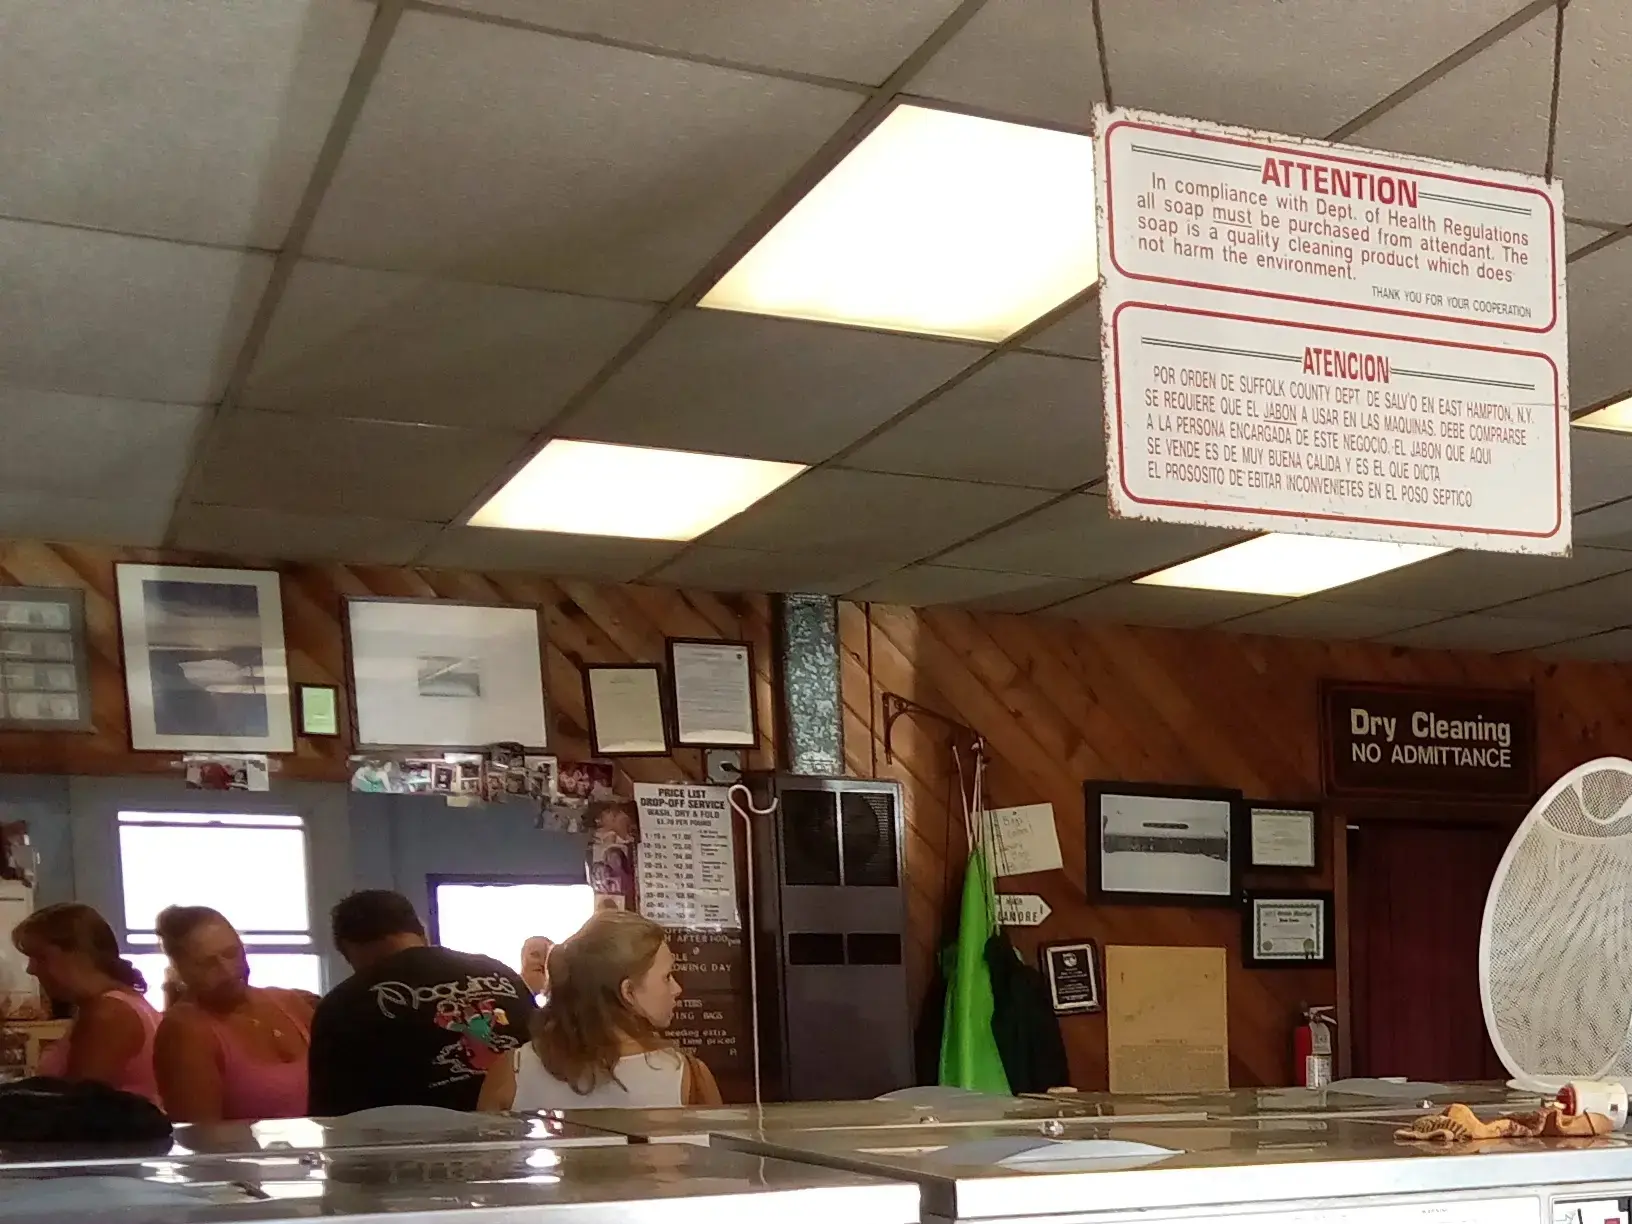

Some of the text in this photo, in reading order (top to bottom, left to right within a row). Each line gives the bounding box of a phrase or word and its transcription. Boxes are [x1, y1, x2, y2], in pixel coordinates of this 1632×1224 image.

[1260, 155, 1419, 209] ATTENTION
[1136, 190, 1528, 266] all soap must be purchased from attendant. The
[1151, 171, 1529, 250] In compliance with Dept. of Health Regulations
[1137, 214, 1513, 283] soap is a quality cleaning product which does
[1137, 234, 1356, 281] not harm the environment.
[1371, 285, 1532, 318] THANK YOU FOR YOUR COOPERATION
[1301, 345, 1390, 384] ATENCION
[1143, 388, 1159, 408] SE
[1163, 390, 1216, 413] REQUIERE
[1219, 396, 1242, 416] QUE
[1246, 399, 1259, 418] EL
[1262, 401, 1297, 422] JABON
[1300, 404, 1308, 423] A
[1312, 406, 1339, 426] USAR
[1342, 410, 1357, 428] EN
[1359, 411, 1380, 431] LAS
[1439, 420, 1465, 440] DEBE
[1468, 423, 1526, 446] COMPRARSE
[1152, 364, 1176, 386] POR
[1179, 367, 1216, 390] ORDEN
[1220, 372, 1234, 392] DE
[1238, 374, 1285, 397] SUFFOLK
[1289, 380, 1331, 402] COUNTY
[1366, 388, 1380, 408] DE
[1420, 394, 1434, 414] EN
[1438, 396, 1463, 417] EAST
[1465, 399, 1514, 423] HAMPTON,
[1516, 405, 1533, 424] N.Y.
[1145, 412, 1154, 431] A
[1158, 413, 1172, 433] LA
[1175, 415, 1226, 438] PERSONA
[1229, 421, 1292, 445] ENCARGADA
[1295, 427, 1310, 446] DE
[1313, 429, 1339, 449] ESTE
[1393, 438, 1406, 457] EL
[1409, 439, 1442, 460] JABON
[1444, 443, 1465, 462] QUE
[1468, 445, 1492, 465] AQUI
[1146, 436, 1441, 482] SE VENDE ES DE MUY BUENA CALIDA Y ES EL QUE DICTA
[1147, 460, 1161, 480] EL
[1164, 461, 1225, 485] PROSOSITO
[1247, 469, 1282, 490] EBITAR
[1367, 480, 1381, 500] EN
[1384, 482, 1397, 501] EL
[1400, 483, 1429, 504] POSO
[1432, 486, 1473, 507] SEPTICO
[1350, 708, 1511, 747] Dry Cleaning
[1351, 742, 1512, 768] NO ADMITTANCE
[640, 798, 725, 810] DROP-OFF SERVICE
[658, 788, 706, 799] PRICE LIST
[700, 811, 720, 819] FOLD
[676, 934, 708, 943] AFTER
[711, 963, 732, 972] DAY
